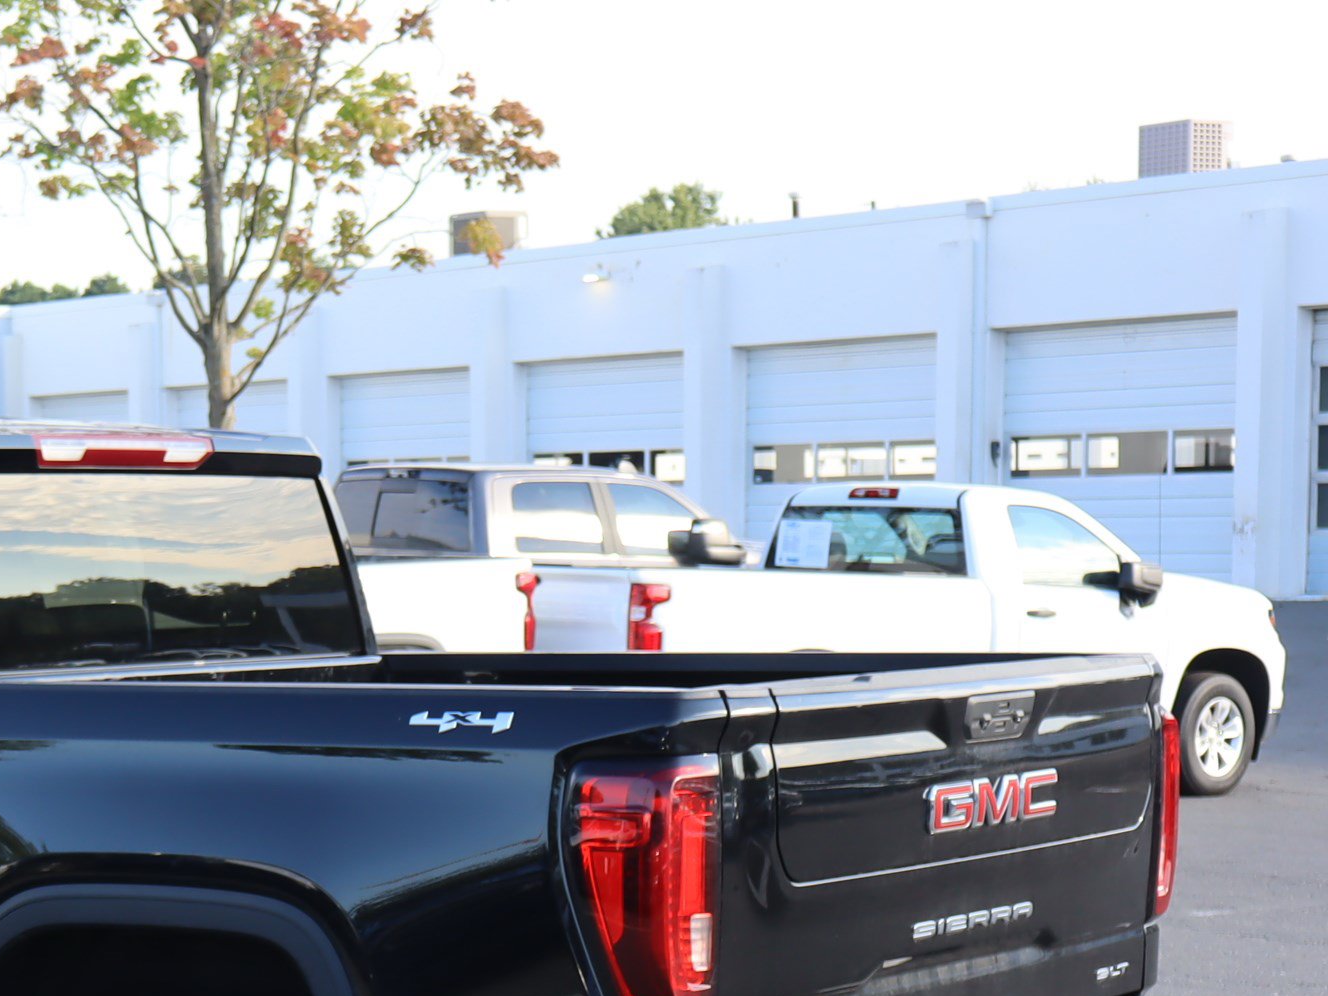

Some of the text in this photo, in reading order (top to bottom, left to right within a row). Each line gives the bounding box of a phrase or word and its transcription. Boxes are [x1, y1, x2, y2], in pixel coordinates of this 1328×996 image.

[923, 768, 1058, 835] GMC
[912, 901, 1033, 942] SIERRA
[1096, 961, 1130, 981] SLT
